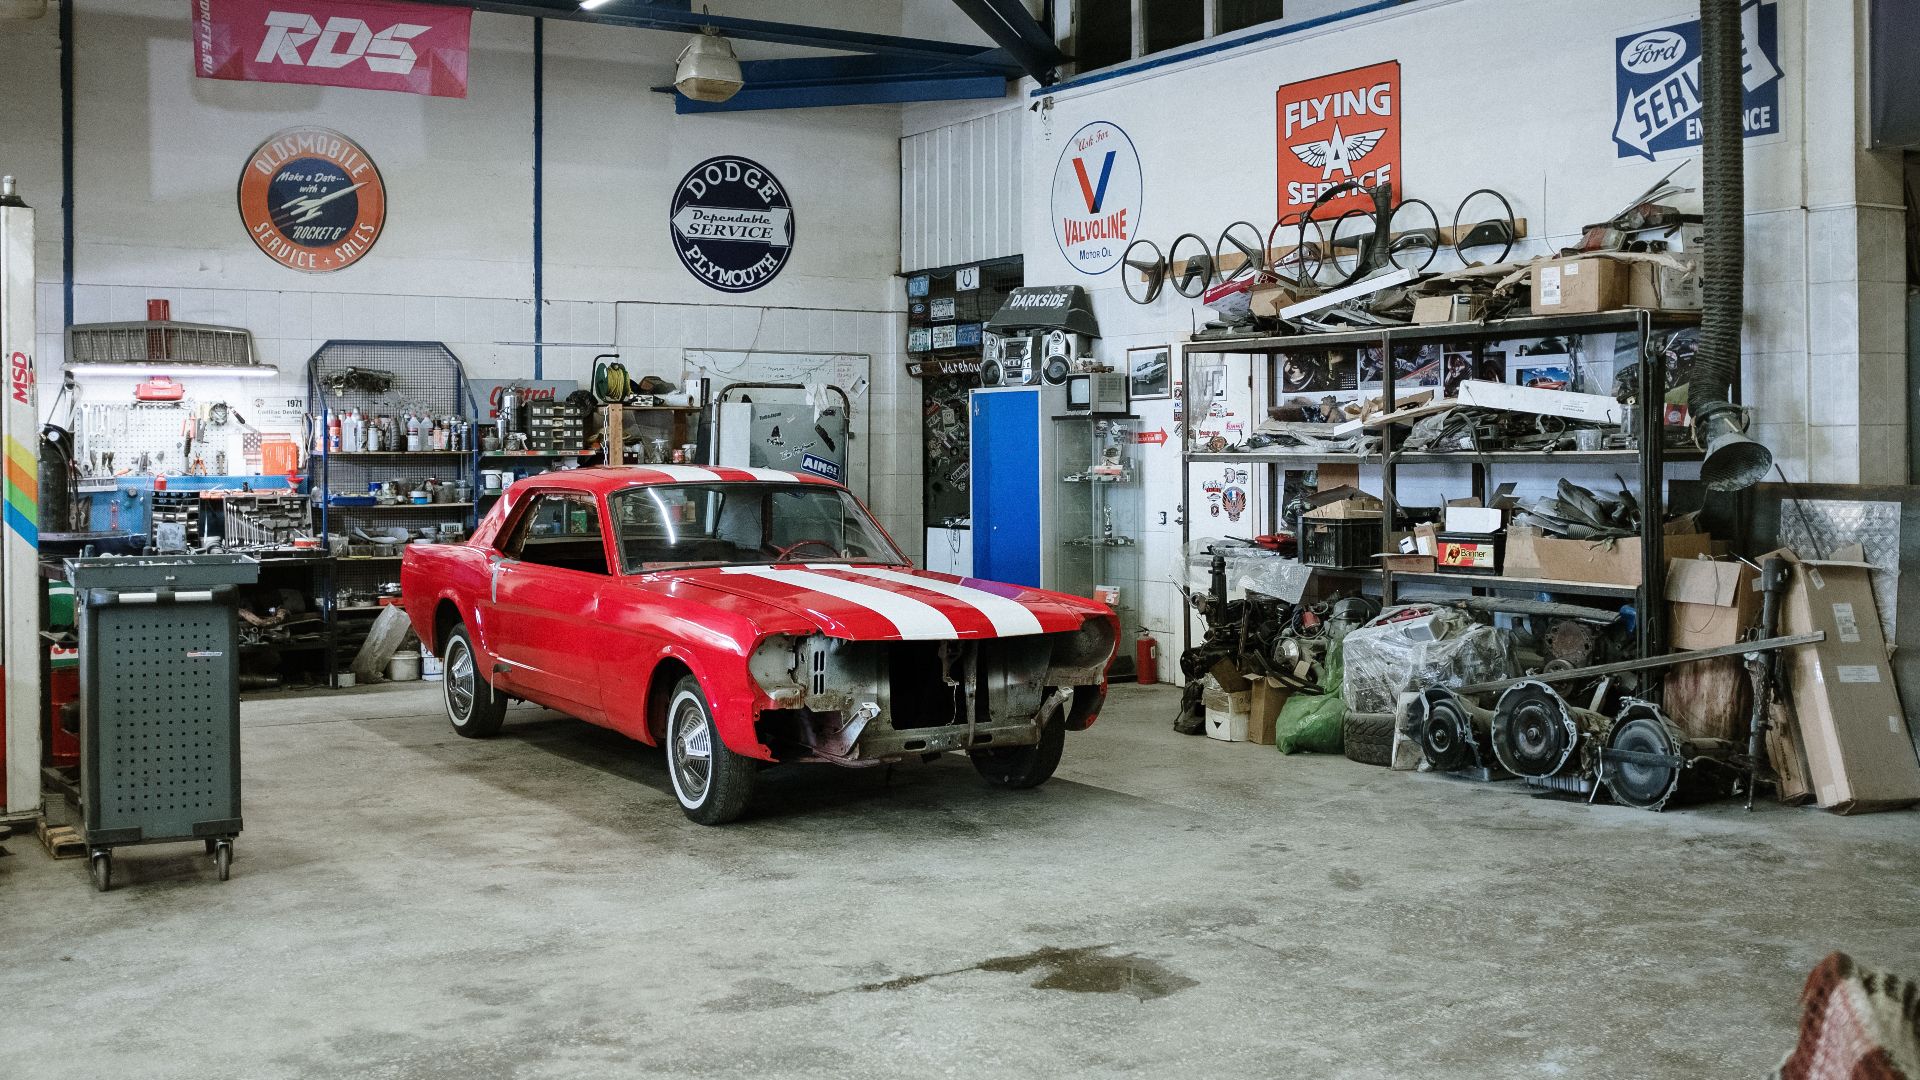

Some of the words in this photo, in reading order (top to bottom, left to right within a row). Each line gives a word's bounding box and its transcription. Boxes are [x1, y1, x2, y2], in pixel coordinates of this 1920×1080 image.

[254, 10, 433, 75] RDS
[1627, 37, 1682, 67] Ford
[1633, 33, 1753, 140] SERV
[1285, 82, 1391, 140] FLYING
[1686, 105, 1771, 141] ENNCE
[1095, 129, 1110, 144] For
[1321, 120, 1353, 181] A
[254, 134, 370, 179] OLDSMOBILE
[276, 171, 303, 183] Make
[299, 183, 318, 193] with
[686, 162, 779, 204] DODGE
[1072, 150, 1117, 214] V
[687, 223, 774, 239] SERVICE
[692, 209, 772, 225] Dependable
[1063, 207, 1127, 247] VALVOLINE
[254, 221, 317, 268] SERVICE
[334, 221, 375, 263] SALES
[685, 244, 779, 286] PLYMOUTH
[1010, 293, 1069, 308] DARKSIDE
[12, 351, 28, 405] MSD
[939, 359, 983, 374] Warehou
[286, 399, 303, 408] 1971
[489, 386, 556, 407] Ctrol
[1460, 548, 1487, 558] Banner
